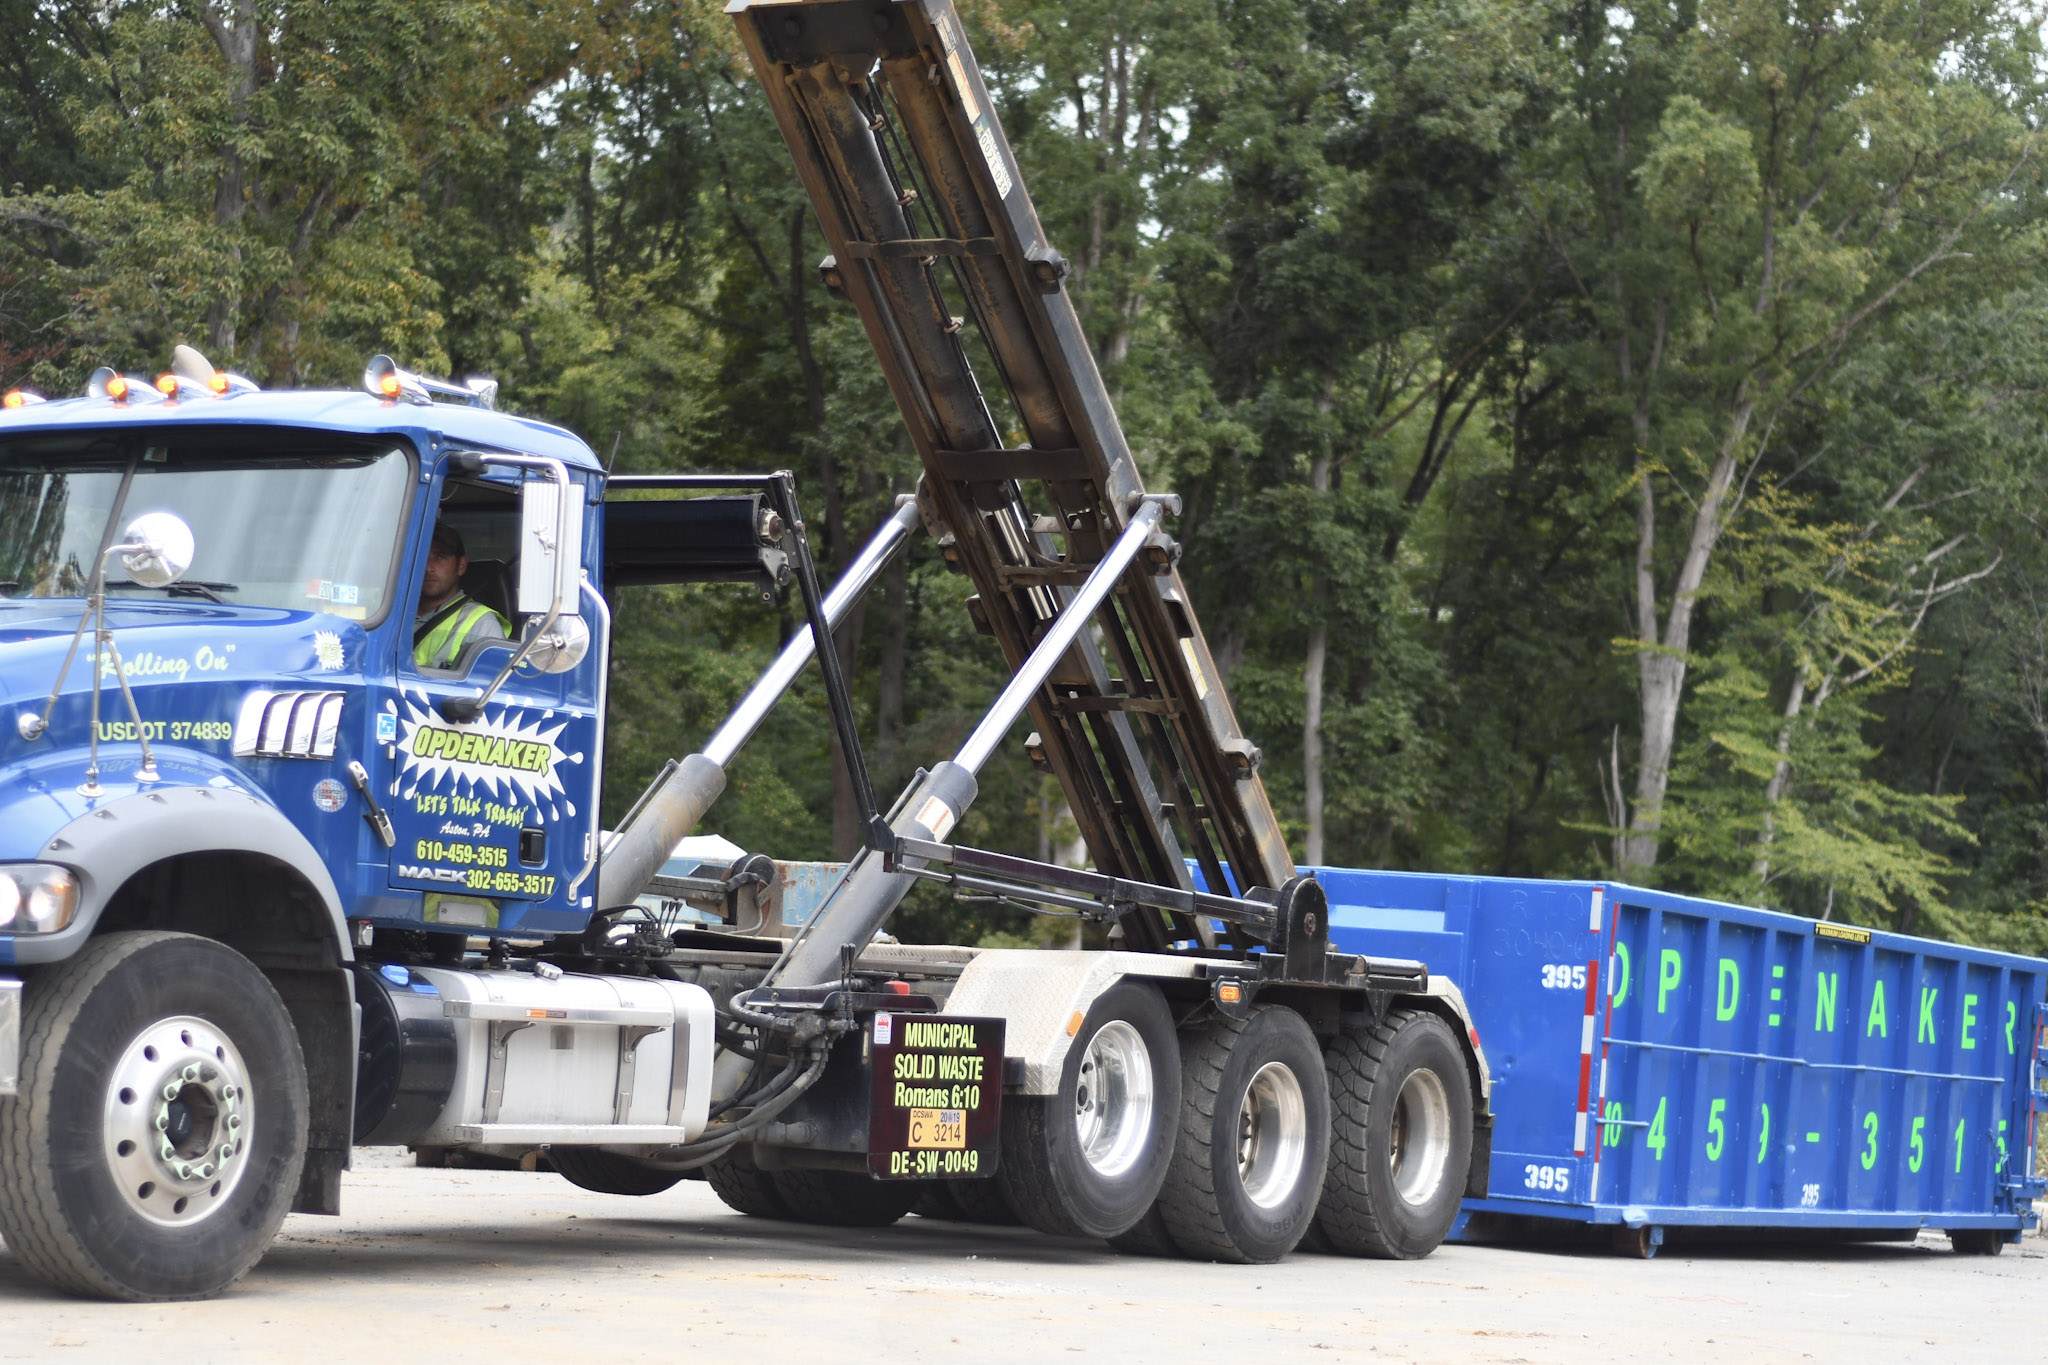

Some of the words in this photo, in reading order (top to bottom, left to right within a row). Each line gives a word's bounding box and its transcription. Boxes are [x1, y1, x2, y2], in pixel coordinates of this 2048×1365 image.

[99, 721, 167, 741] USDOT
[171, 722, 232, 740] 374839
[413, 726, 551, 776] OPDENAKER
[452, 795, 481, 817] TALK
[473, 823, 491, 838] PA
[416, 839, 508, 868] 610-459-3515
[398, 864, 467, 883] MACK
[466, 868, 555, 895] 302-655-3517
[1541, 964, 1586, 989] 395
[904, 1022, 977, 1049] MUNICIPAL
[894, 1053, 936, 1079] SOLID
[938, 1055, 984, 1081] WASTE
[894, 1082, 949, 1108] Romans
[951, 1085, 980, 1109] 6:10
[912, 1110, 934, 1119] DCSWA
[912, 1121, 923, 1143] C
[934, 1123, 961, 1142] 3214
[891, 1149, 978, 1174] DE-SW-0049
[1524, 1164, 1569, 1192] 395
[1801, 1183, 1820, 1206] 395
